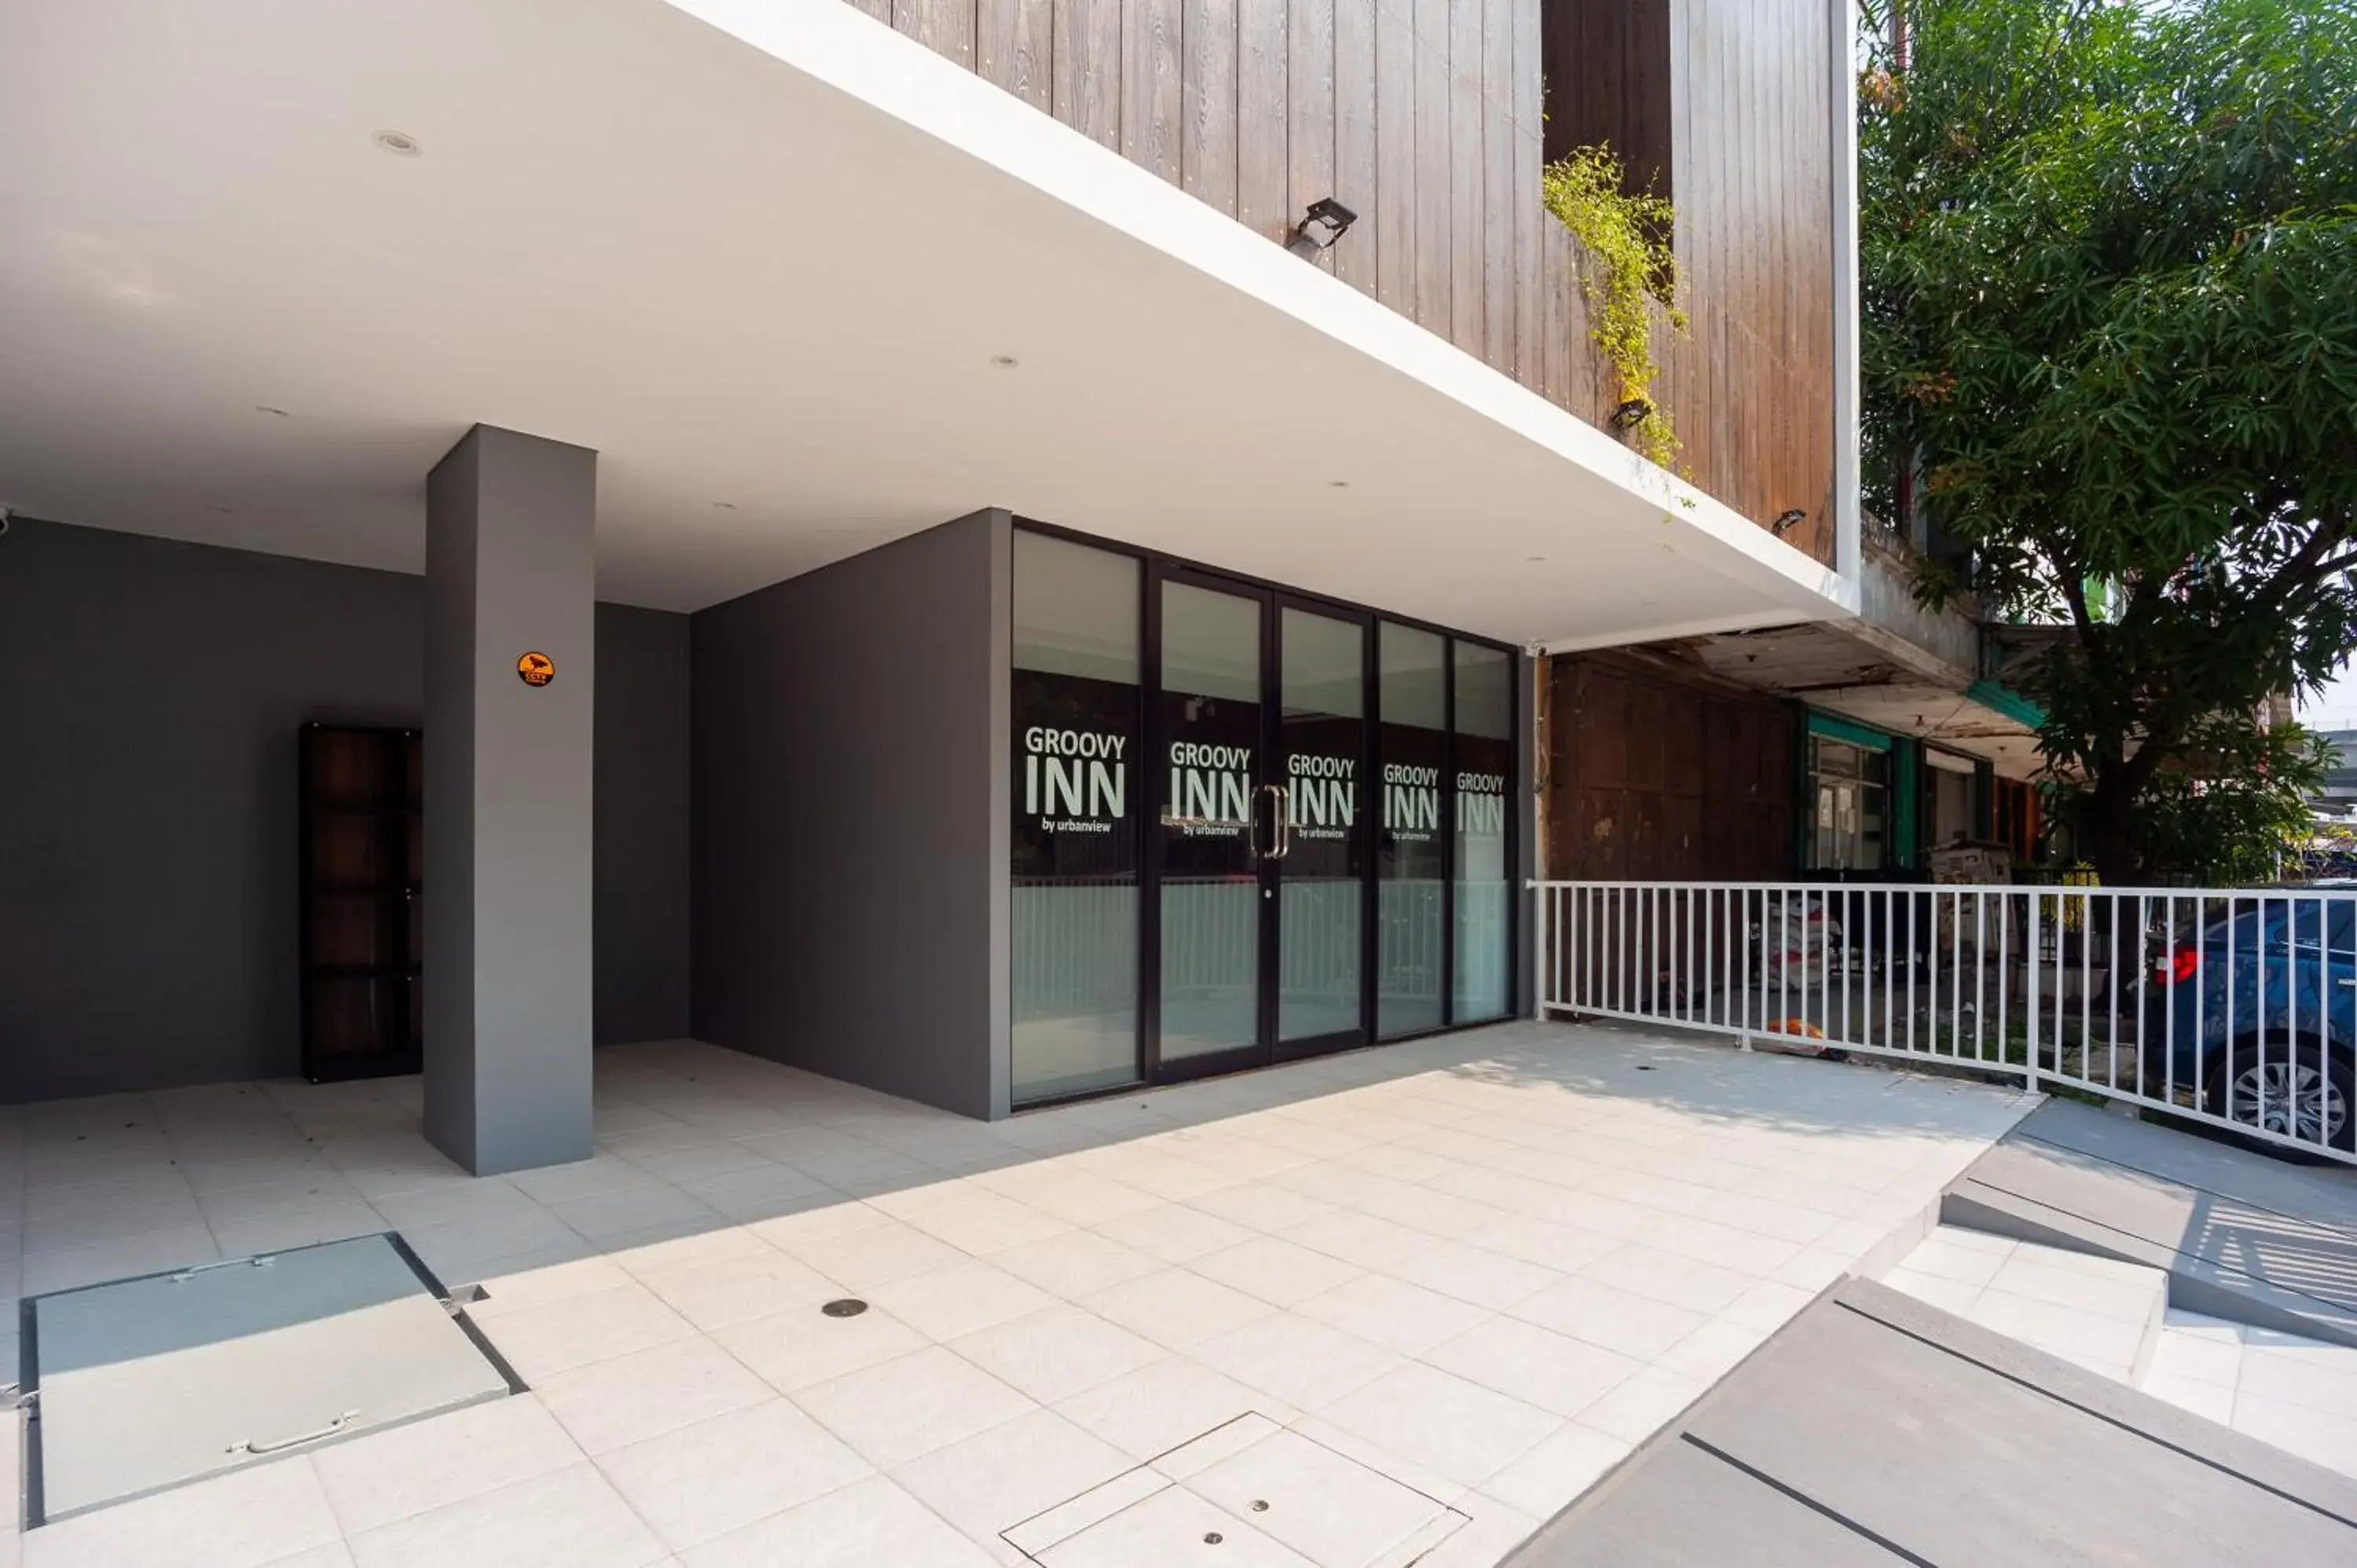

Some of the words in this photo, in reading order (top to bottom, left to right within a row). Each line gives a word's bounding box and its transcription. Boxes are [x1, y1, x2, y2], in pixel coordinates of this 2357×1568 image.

[1025, 727, 1126, 760] GROOVY
[1171, 742, 1251, 771] GROOVY
[1288, 753, 1355, 779] GROOVY
[1384, 764, 1439, 786] GROOVY
[1026, 755, 1125, 818] INN
[1171, 767, 1250, 823] INN
[1457, 772, 1505, 792] GROOVY
[1288, 776, 1354, 826] INN
[1384, 784, 1438, 830] INN
[1457, 791, 1504, 833] INN
[1042, 817, 1054, 833] by
[1057, 819, 1112, 833] urbanview
[1184, 824, 1194, 837] by
